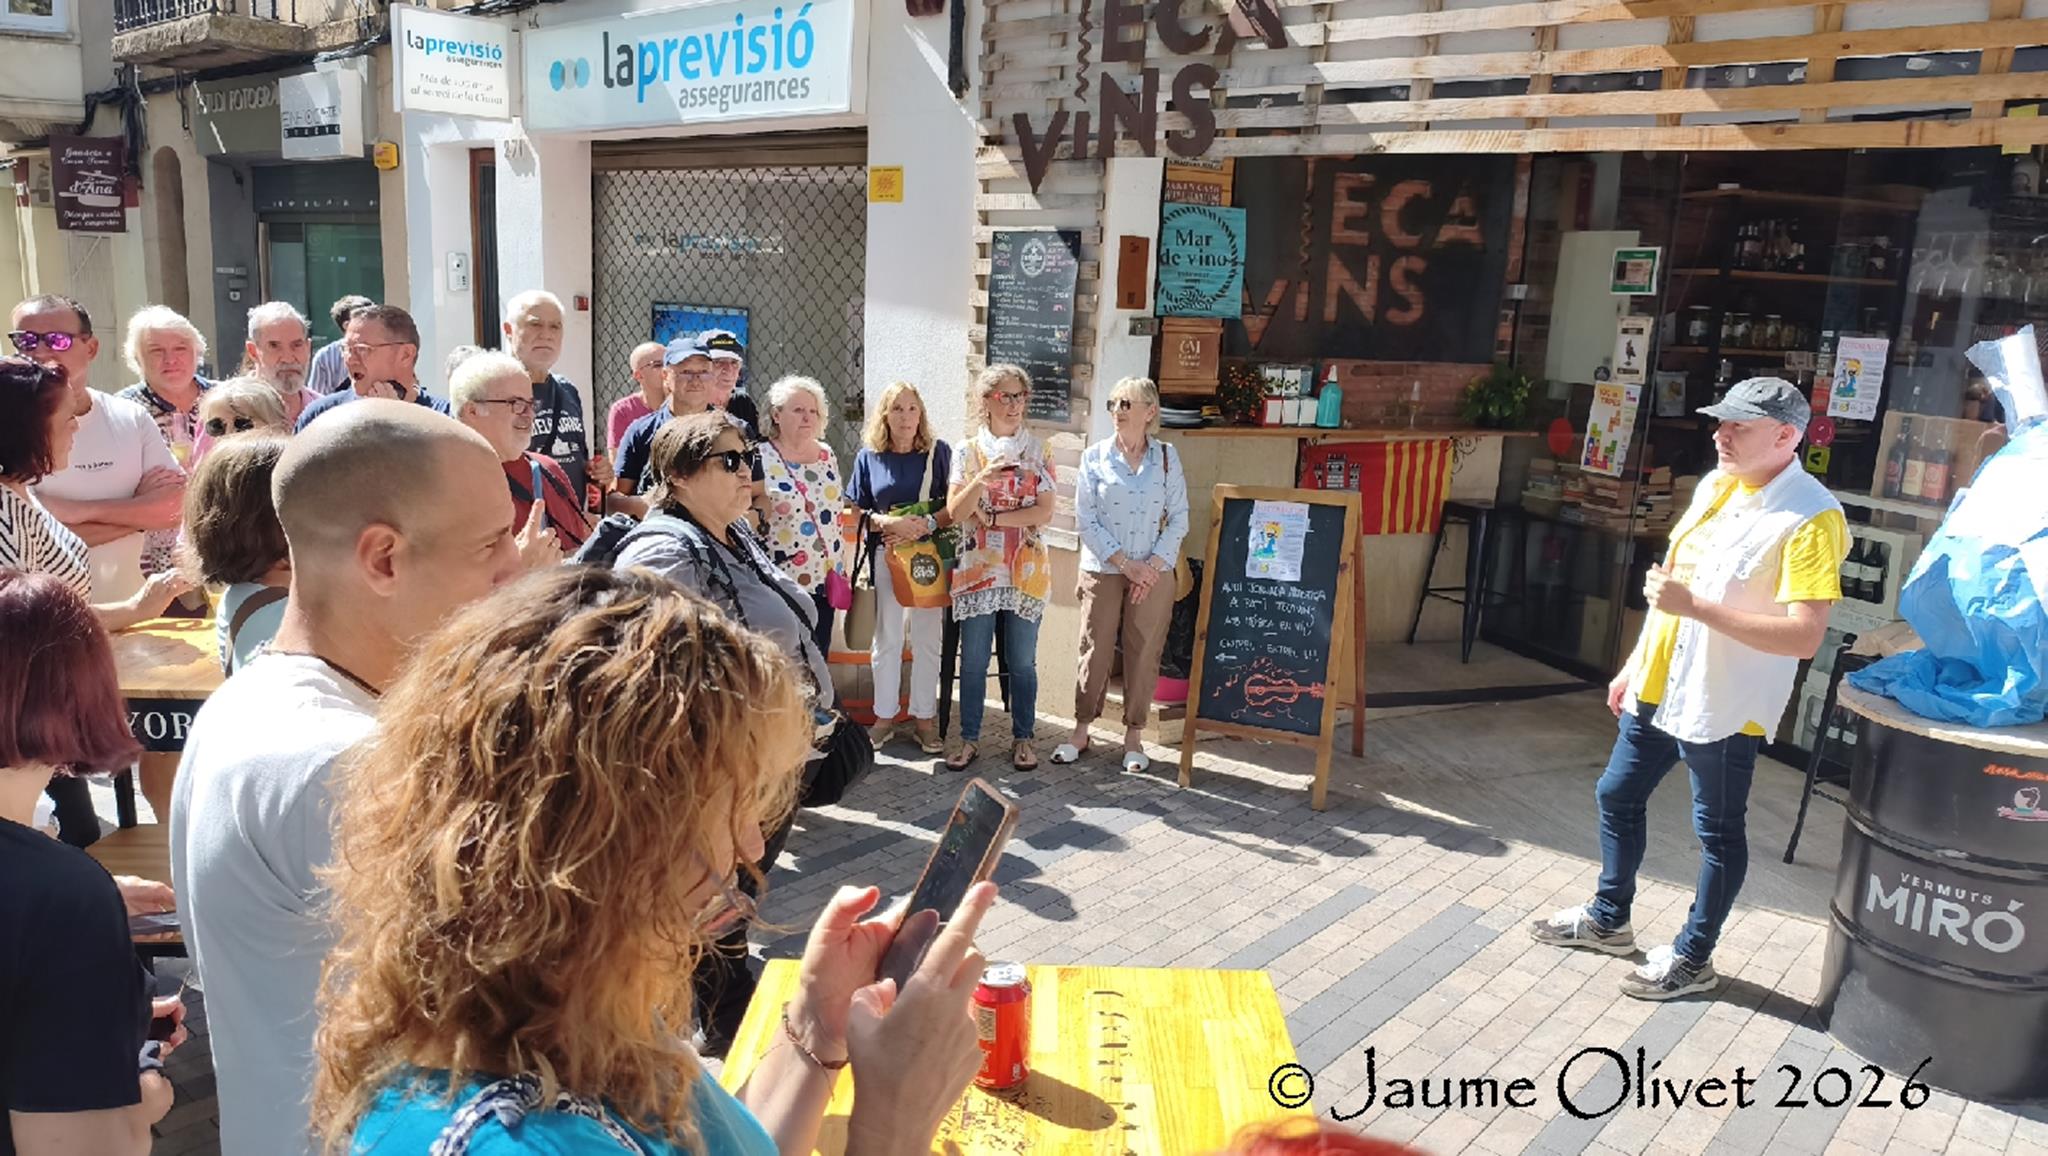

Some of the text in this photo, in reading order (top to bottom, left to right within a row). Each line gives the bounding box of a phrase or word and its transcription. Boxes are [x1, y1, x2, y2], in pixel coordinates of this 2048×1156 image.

[407, 30, 503, 60] laprevisió
[602, 3, 815, 103] laprevisió
[679, 76, 811, 113] assegurances
[1013, 63, 1220, 194] VINS
[1176, 229, 1212, 248] Mar
[1160, 248, 1228, 267] de vino
[1900, 871, 1993, 905] VERMUTS
[1866, 873, 2025, 953] MIRÓ
